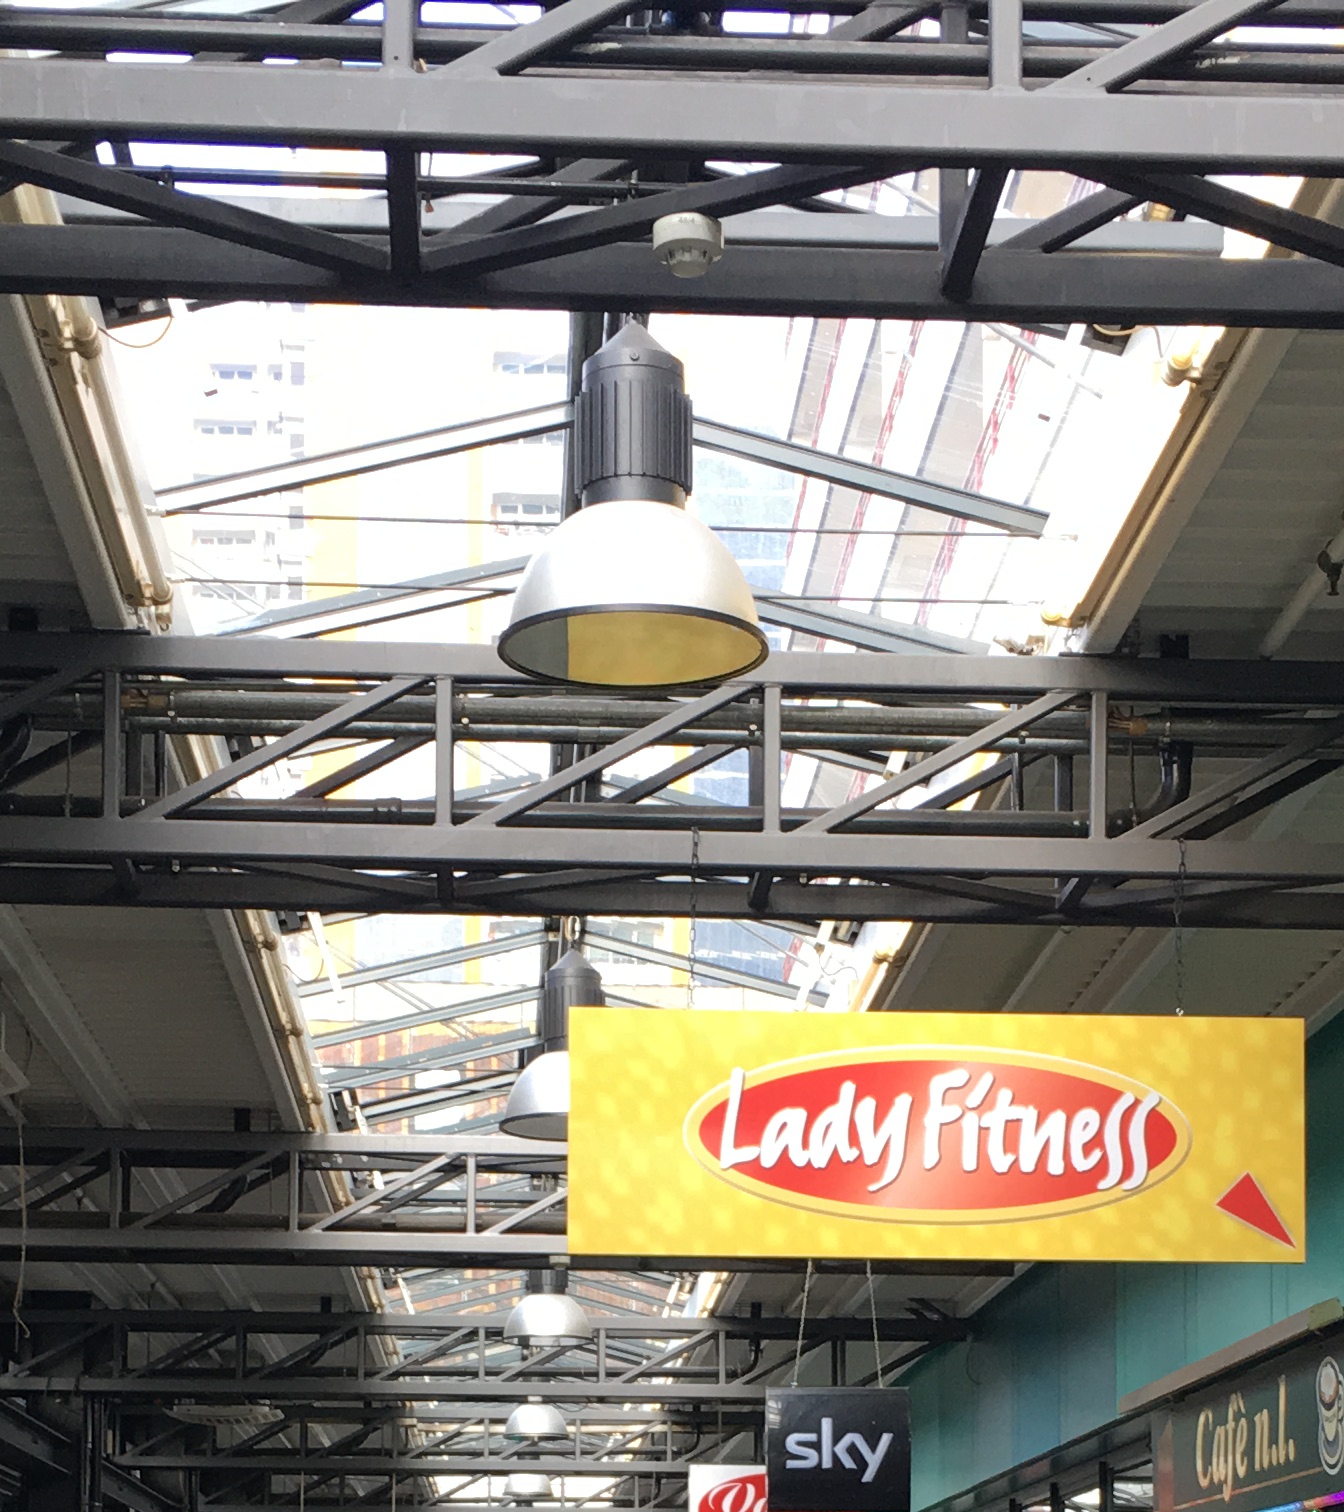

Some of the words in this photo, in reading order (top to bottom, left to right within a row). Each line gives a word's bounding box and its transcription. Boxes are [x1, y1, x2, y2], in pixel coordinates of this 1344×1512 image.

[719, 1067, 913, 1193] Lady
[923, 1068, 1161, 1191] Fitness
[785, 1417, 895, 1484] sky
